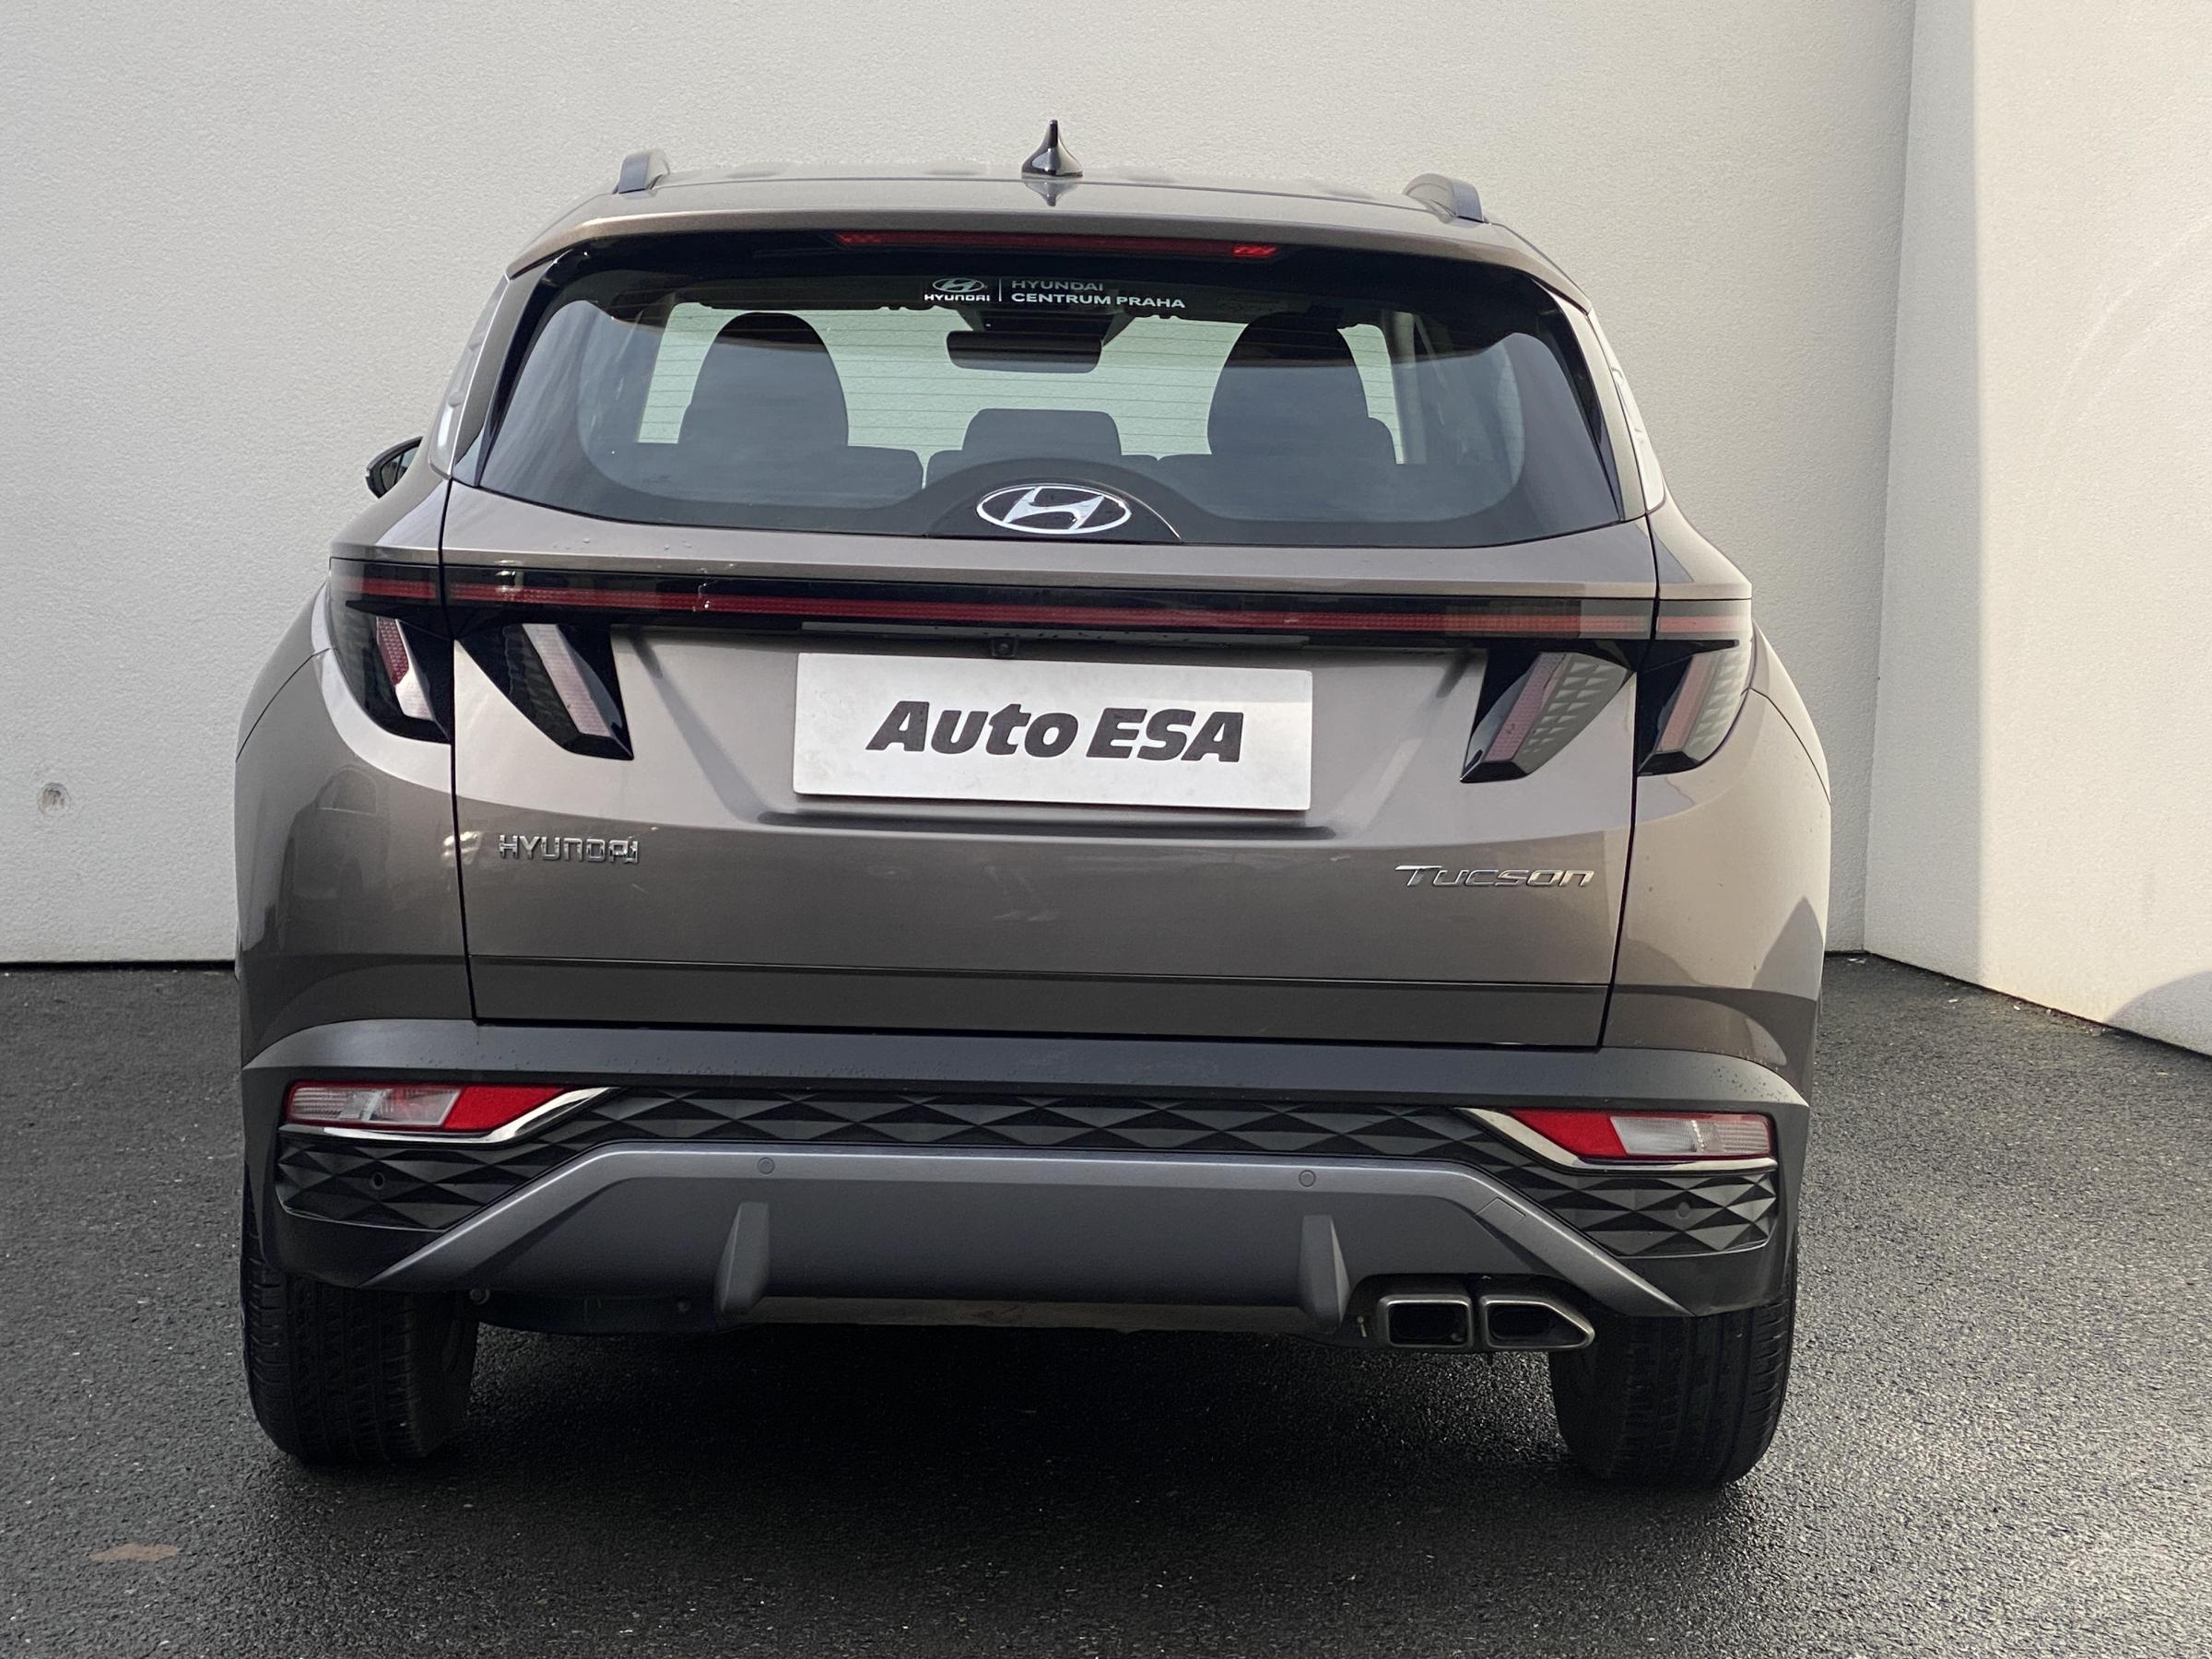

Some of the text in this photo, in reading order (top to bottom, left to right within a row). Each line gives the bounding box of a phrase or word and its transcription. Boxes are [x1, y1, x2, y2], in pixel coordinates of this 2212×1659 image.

[1012, 279, 1103, 291] HYUNDAI
[924, 294, 991, 302] HYUNDAI
[1011, 292, 1186, 309] CENTRUM PRAHA
[865, 700, 1244, 762] Auto ESA
[499, 834, 639, 864] HYUNDAI
